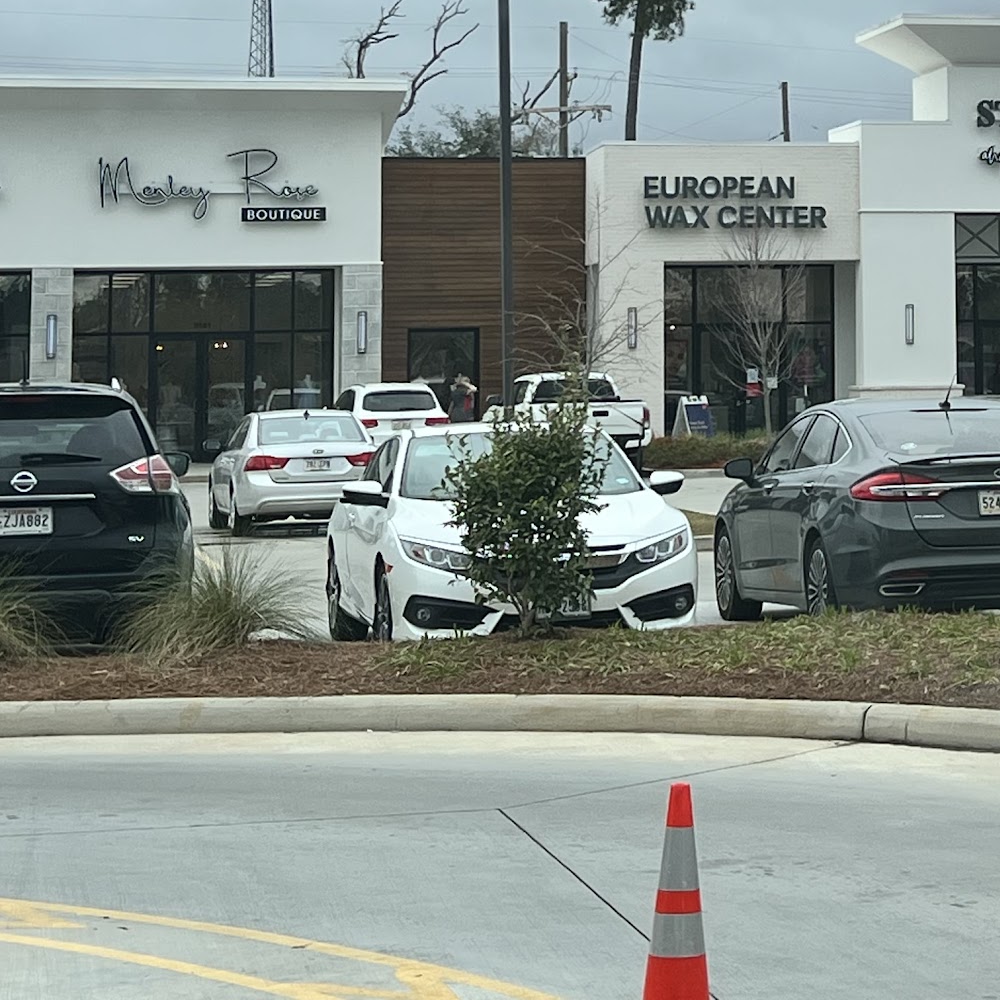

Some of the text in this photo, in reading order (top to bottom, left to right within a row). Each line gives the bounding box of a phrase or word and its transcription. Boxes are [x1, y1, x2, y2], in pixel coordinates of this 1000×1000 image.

[226, 148, 319, 204] Rose
[643, 175, 796, 199] EUROPEAN
[246, 209, 321, 222] BOUTIQUE
[644, 205, 828, 229] WAX CENTER
